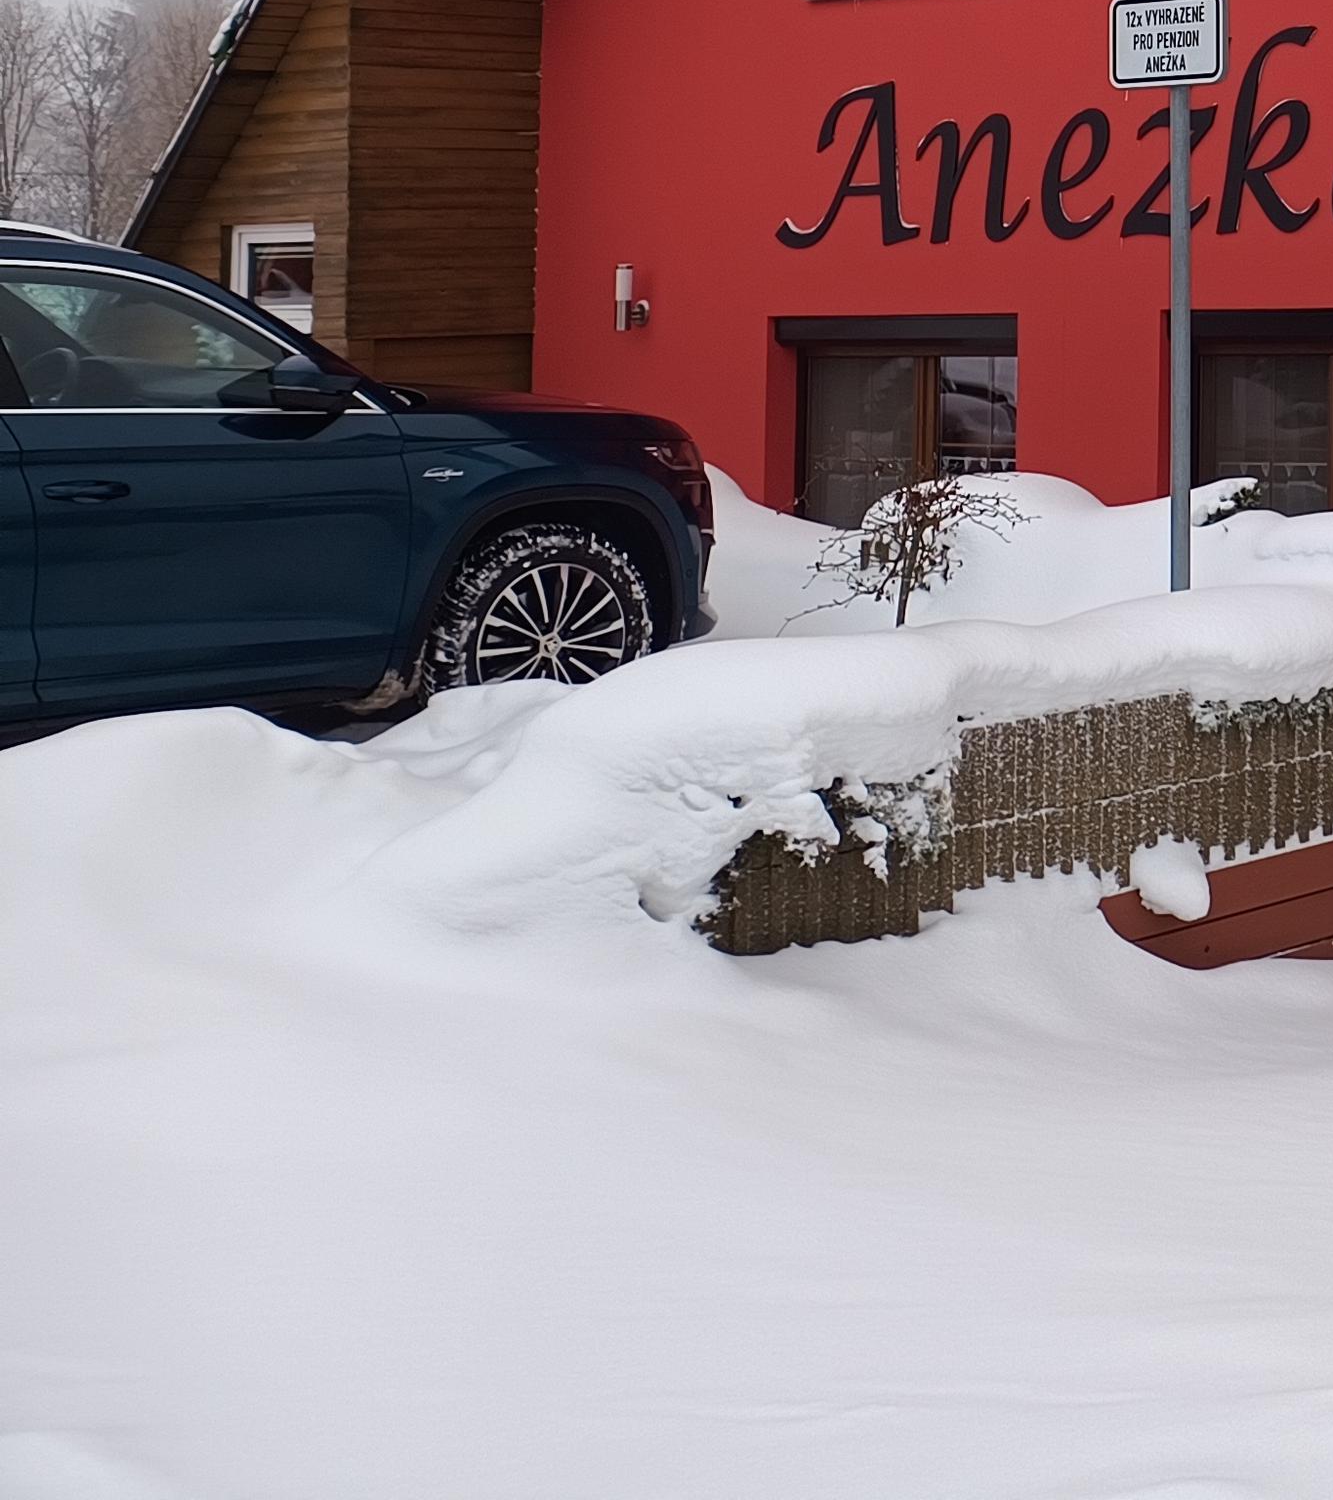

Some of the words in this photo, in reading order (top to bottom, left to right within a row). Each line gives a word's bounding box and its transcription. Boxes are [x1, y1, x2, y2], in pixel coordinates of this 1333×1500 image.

[1126, 11, 1143, 28] 12x
[1145, 2, 1205, 26] VYHRAZENÉ
[1133, 33, 1154, 50] PRO
[1157, 29, 1200, 49] PENZION
[1145, 51, 1187, 73] ANEŽKA
